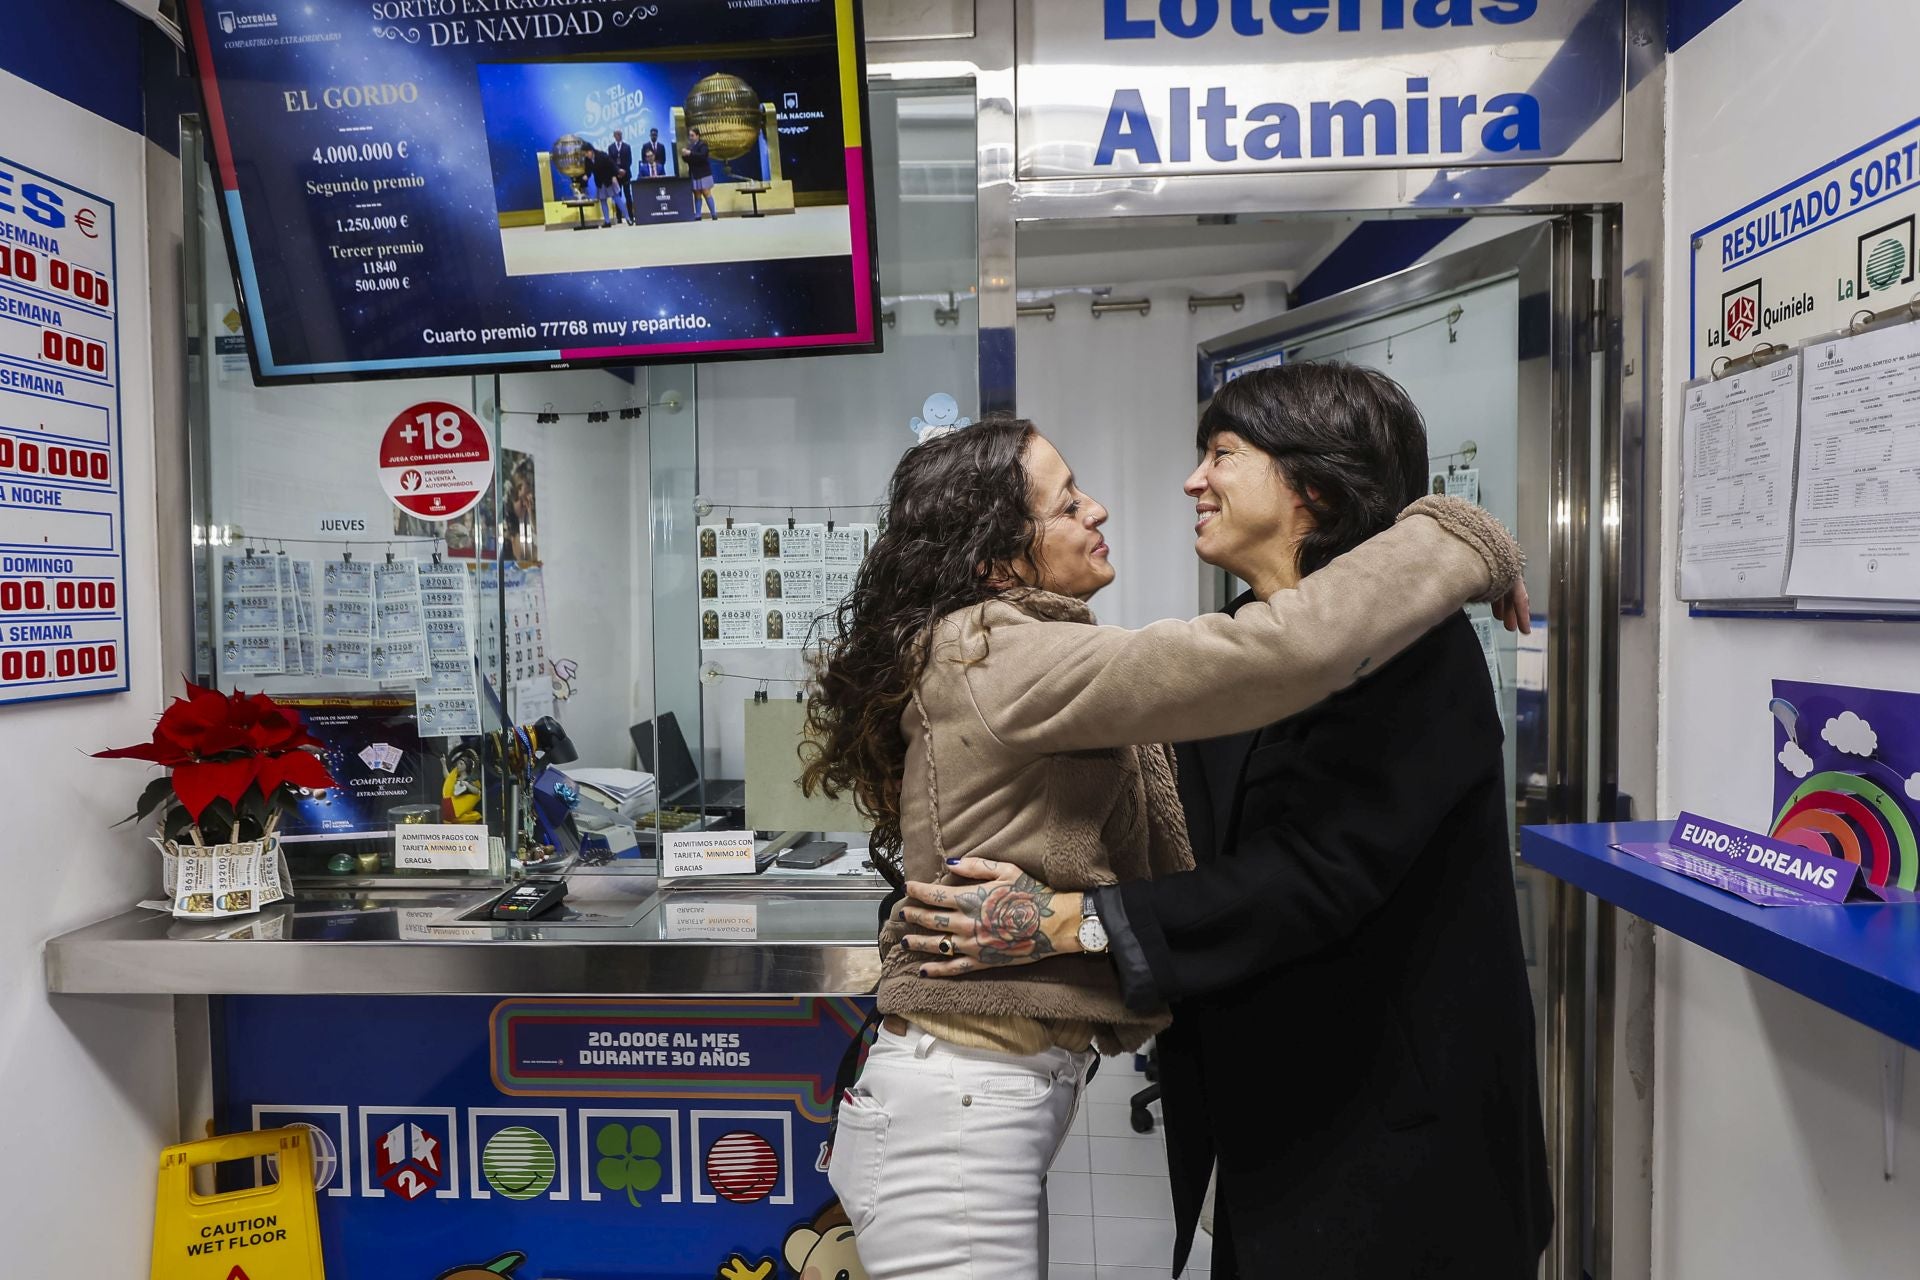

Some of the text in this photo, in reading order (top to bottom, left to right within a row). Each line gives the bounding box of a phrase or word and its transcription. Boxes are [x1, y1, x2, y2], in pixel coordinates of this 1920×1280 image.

[373, 0, 457, 21] SORTEO
[430, 10, 603, 47] DE NAVIDAD
[284, 83, 418, 112] EL GORDO
[789, 111, 824, 120] NACIONAL
[1094, 77, 1541, 167] Altamira
[313, 140, 409, 165] 4.000.000 €
[307, 173, 426, 197] Segundo premio
[1722, 140, 1920, 265] RESULTADO SORT
[336, 215, 410, 233] 1.250.000 €
[330, 240, 424, 259] Tercer premio
[363, 260, 397, 275] 11840
[356, 277, 410, 293] 500.000 €
[1837, 277, 1854, 303] La
[423, 310, 712, 346] Cuarto premio 77768 muy repartido.
[1708, 293, 1814, 348] La Quiniela
[1817, 358, 1844, 369] LOTERÍAS
[0, 366, 64, 397] SEMANA
[399, 411, 463, 450] +18
[389, 451, 480, 463] JUEGA CON RESPONSABILIDAD
[12, 486, 62, 506] NOCHE
[320, 519, 365, 532] JUEVES
[3, 557, 73, 574] DOMINGO
[784, 570, 812, 578] 00572
[10, 625, 73, 642] SEMANA
[350, 776, 413, 786] COMPARTIRLO
[1680, 823, 1729, 854] EURO
[1746, 845, 1839, 890] DREAMS
[185, 859, 194, 891] 86356
[218, 857, 227, 890] 39200
[675, 864, 703, 872] GRACIAS
[588, 1032, 740, 1048] 20.000€ AL MES
[579, 1047, 751, 1067] DURANTE 30 AÑOS
[201, 1215, 278, 1239] CAUTION
[187, 1229, 287, 1258] WET FLOOR
